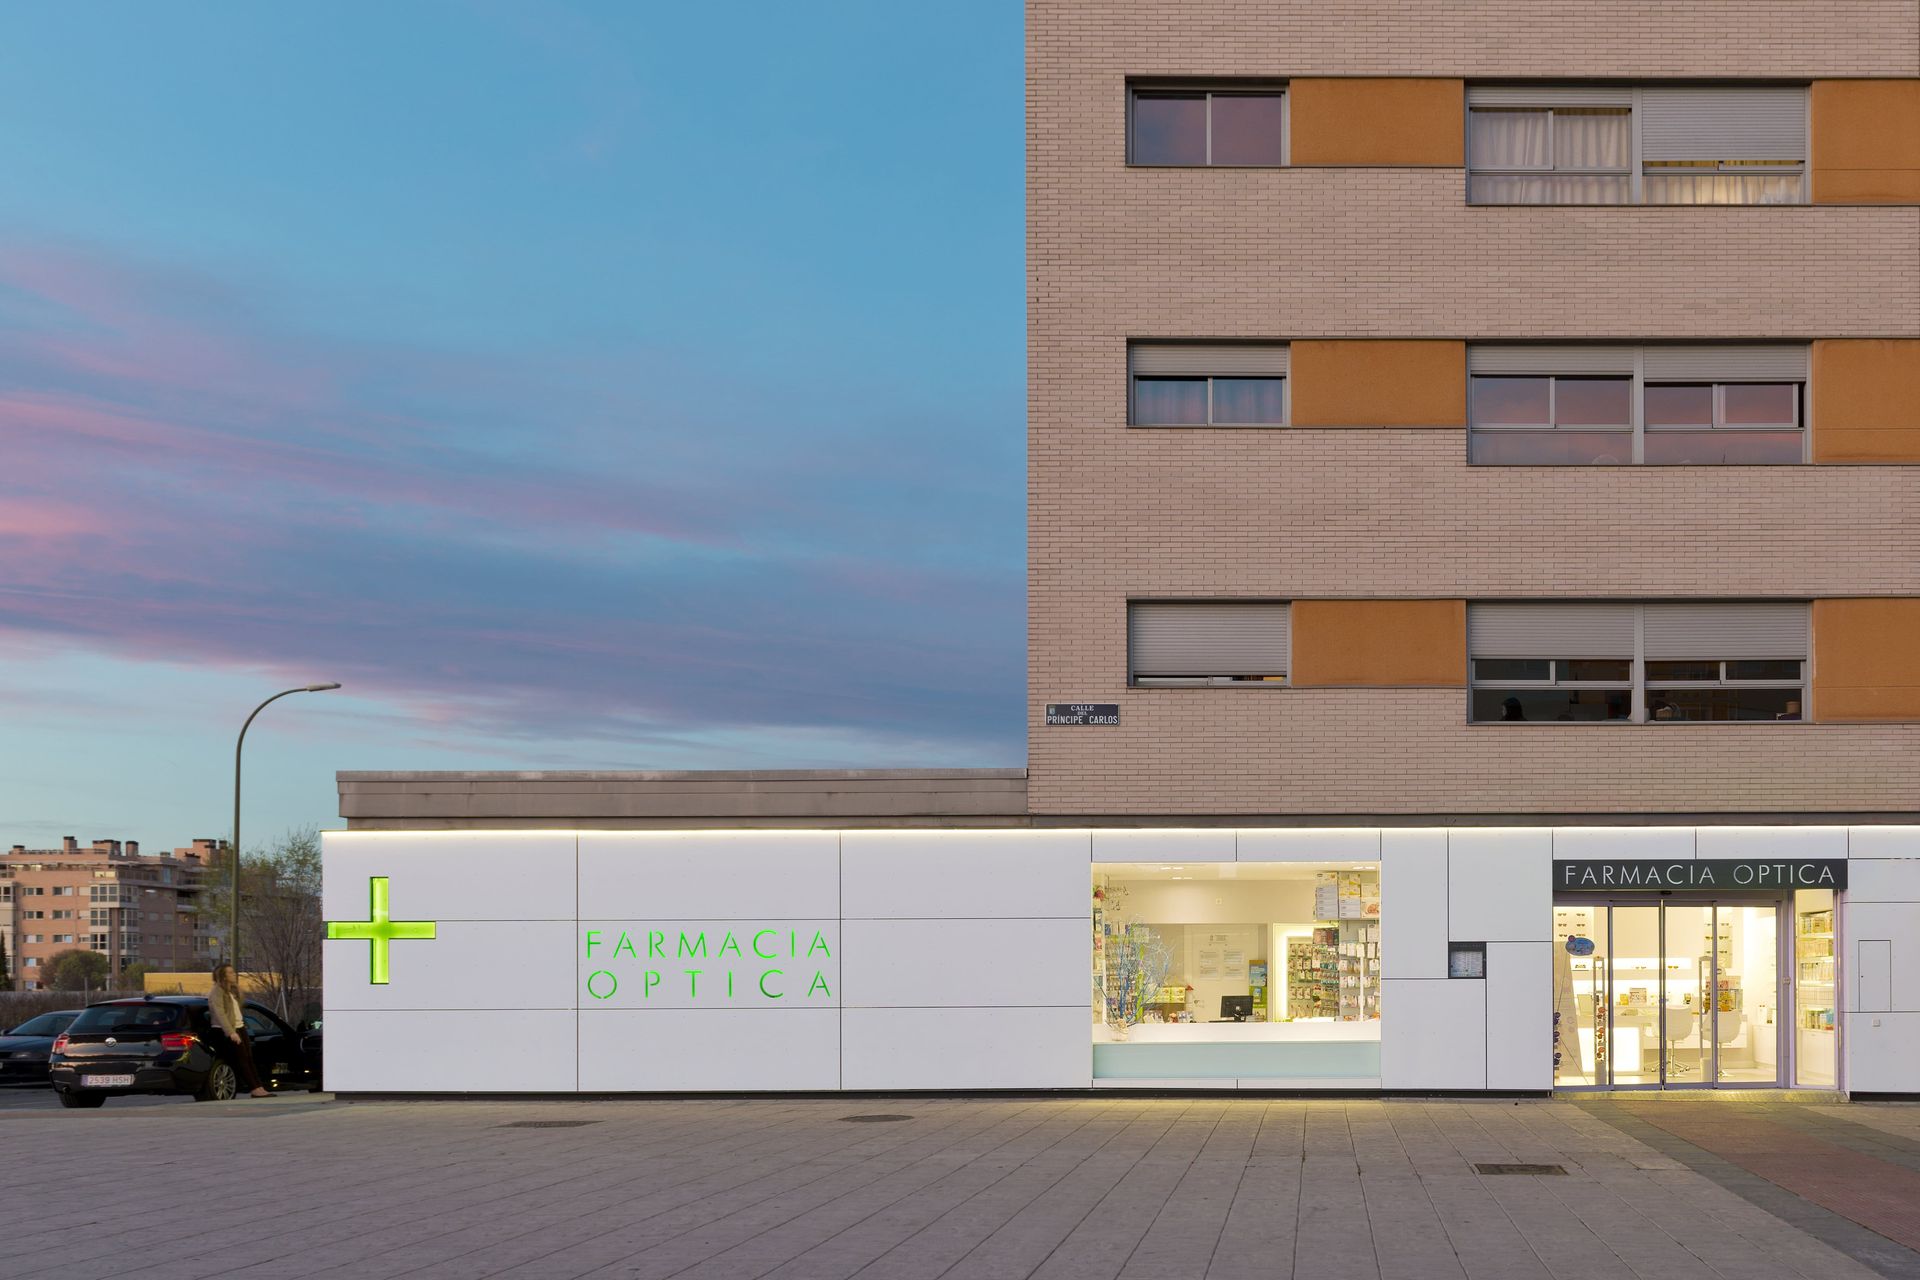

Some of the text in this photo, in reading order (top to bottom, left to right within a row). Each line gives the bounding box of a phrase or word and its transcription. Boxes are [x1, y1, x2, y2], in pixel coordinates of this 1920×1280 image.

[1047, 714, 1118, 724] PRÍNCIPE CARLOS
[1565, 864, 1835, 885] FARMACIA OPTICA
[587, 929, 831, 959] FARMACIA
[587, 969, 831, 999] OPTICA
